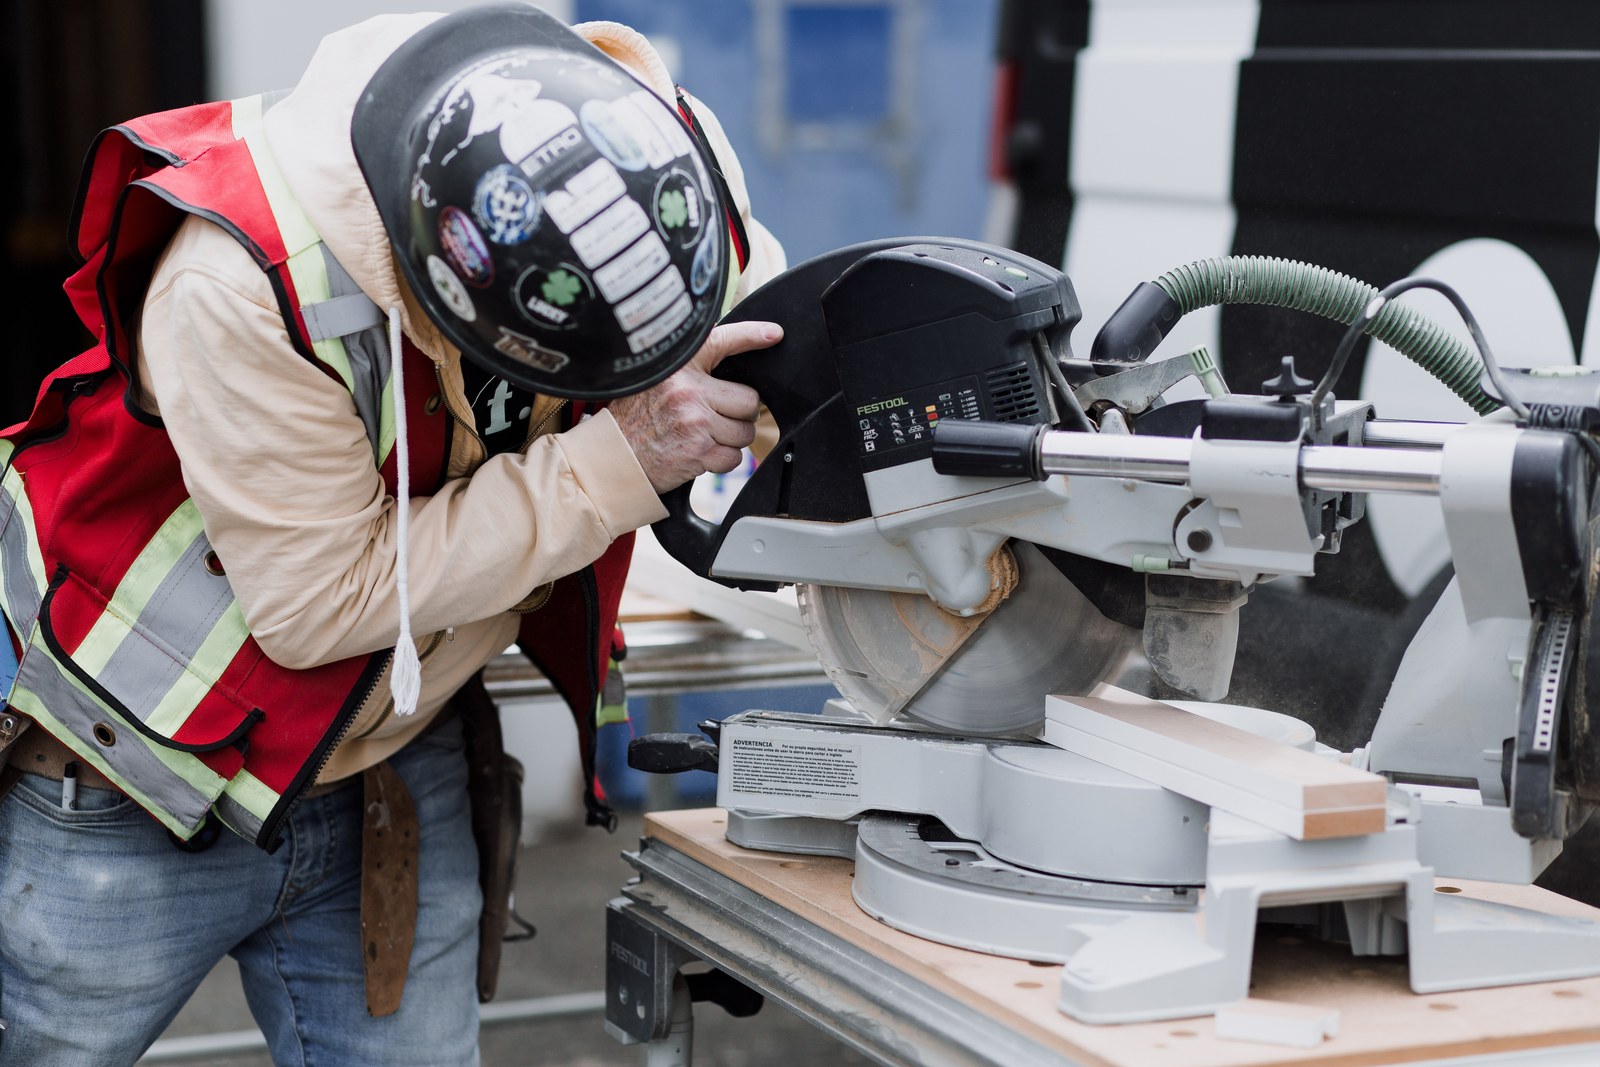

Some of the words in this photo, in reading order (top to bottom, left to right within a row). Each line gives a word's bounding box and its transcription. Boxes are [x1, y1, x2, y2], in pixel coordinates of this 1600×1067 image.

[856, 397, 909, 416] FESTOOL
[733, 739, 773, 748] ADVERTENCIA
[610, 941, 650, 977] FESTOOL
